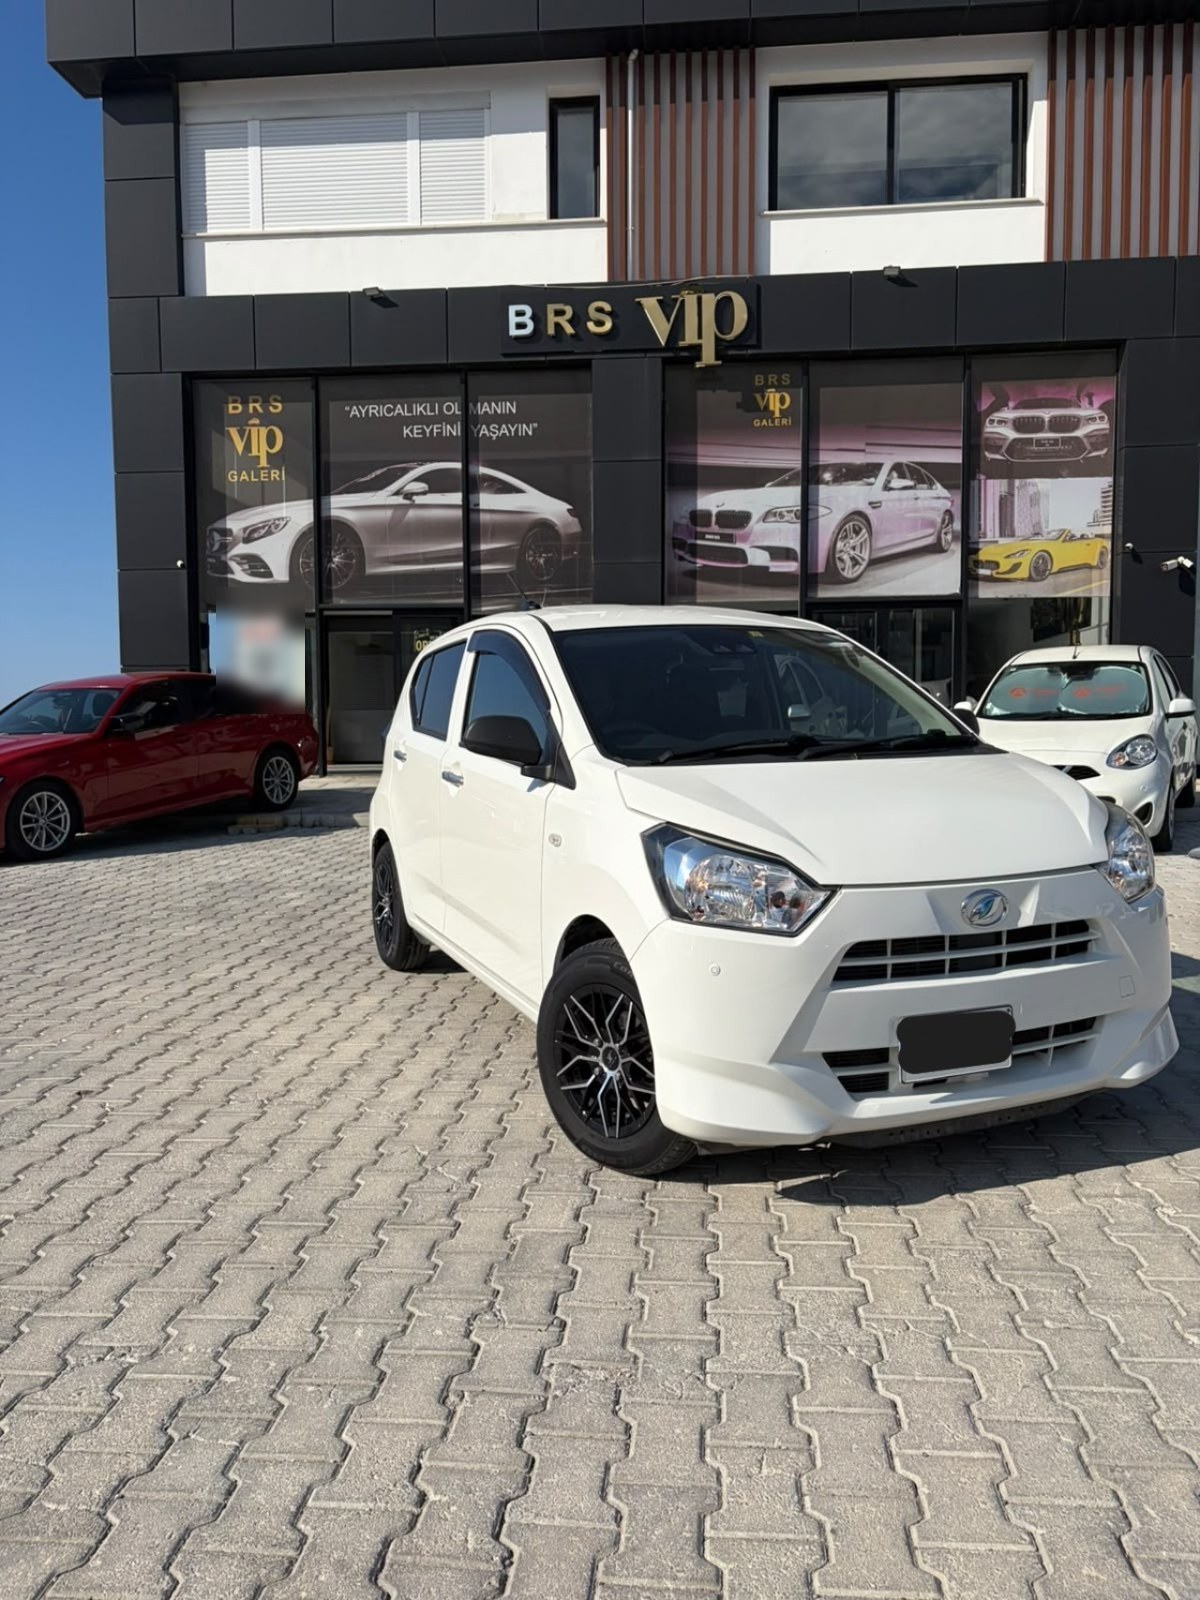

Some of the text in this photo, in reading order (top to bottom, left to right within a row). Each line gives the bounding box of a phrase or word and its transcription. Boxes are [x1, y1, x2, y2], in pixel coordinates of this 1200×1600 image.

[508, 301, 613, 338] BRS
[754, 373, 791, 386] BRS
[227, 394, 283, 414] BRS
[403, 421, 461, 438] KEYFİNİ
